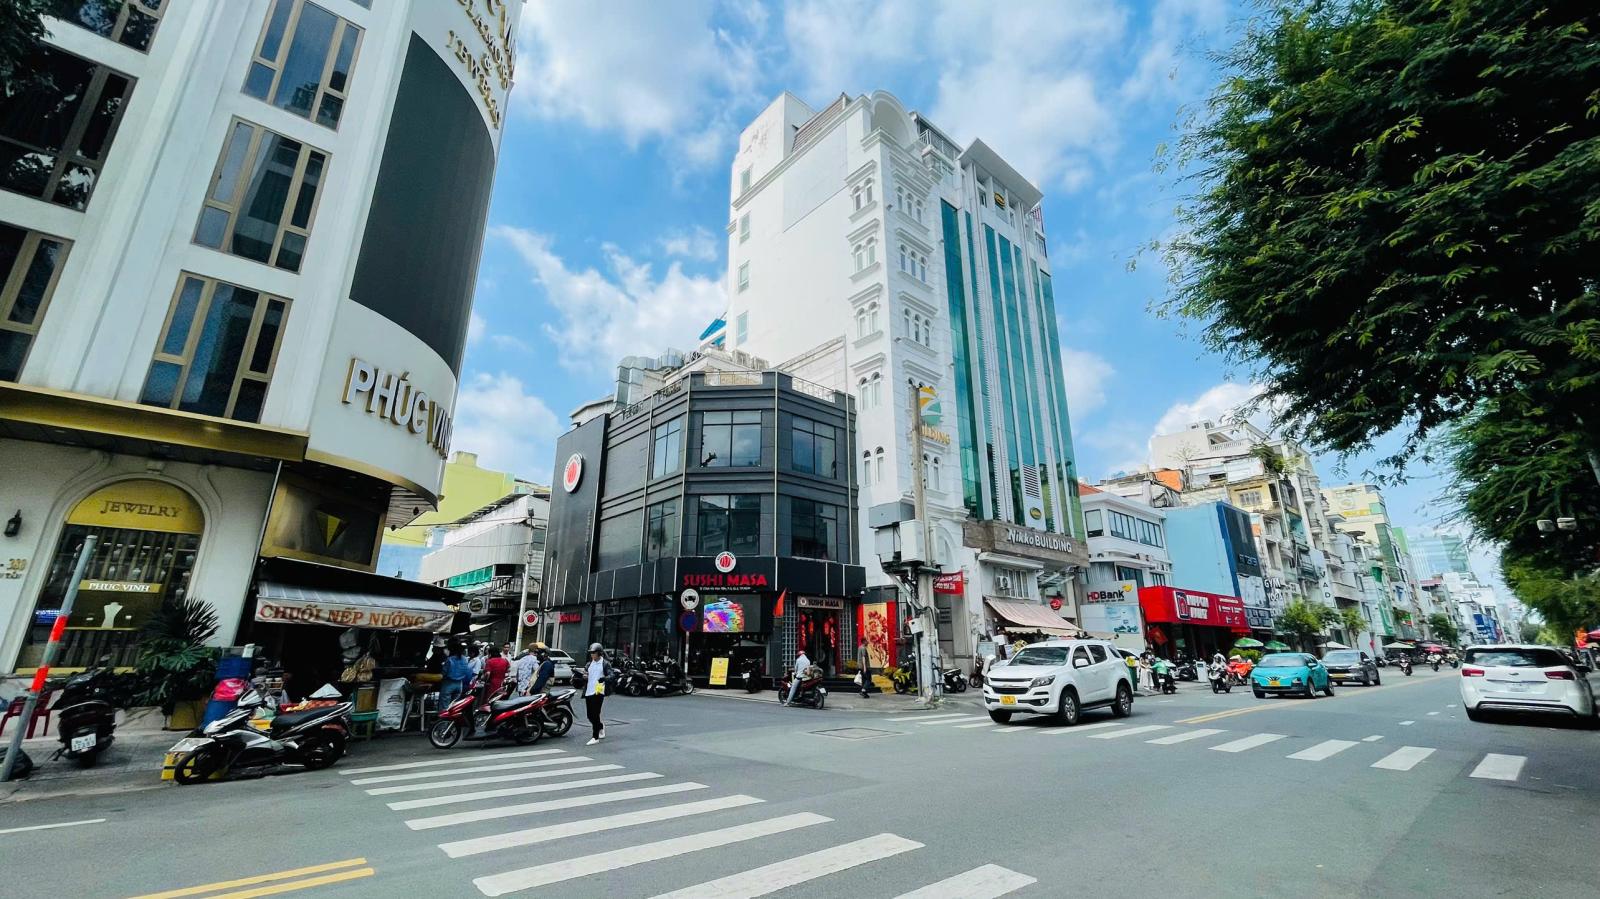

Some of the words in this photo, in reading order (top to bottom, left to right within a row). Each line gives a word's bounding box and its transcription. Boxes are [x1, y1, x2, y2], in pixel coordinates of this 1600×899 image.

[341, 358, 429, 434] PHÚC
[100, 501, 182, 518] JEWELRY
[1006, 528, 1034, 545] Nikko
[1034, 535, 1073, 553] BUILDING
[683, 574, 723, 586] SUSHI
[726, 574, 768, 586] MASA
[122, 584, 151, 592] VINH
[1087, 590, 1124, 601] HDBank
